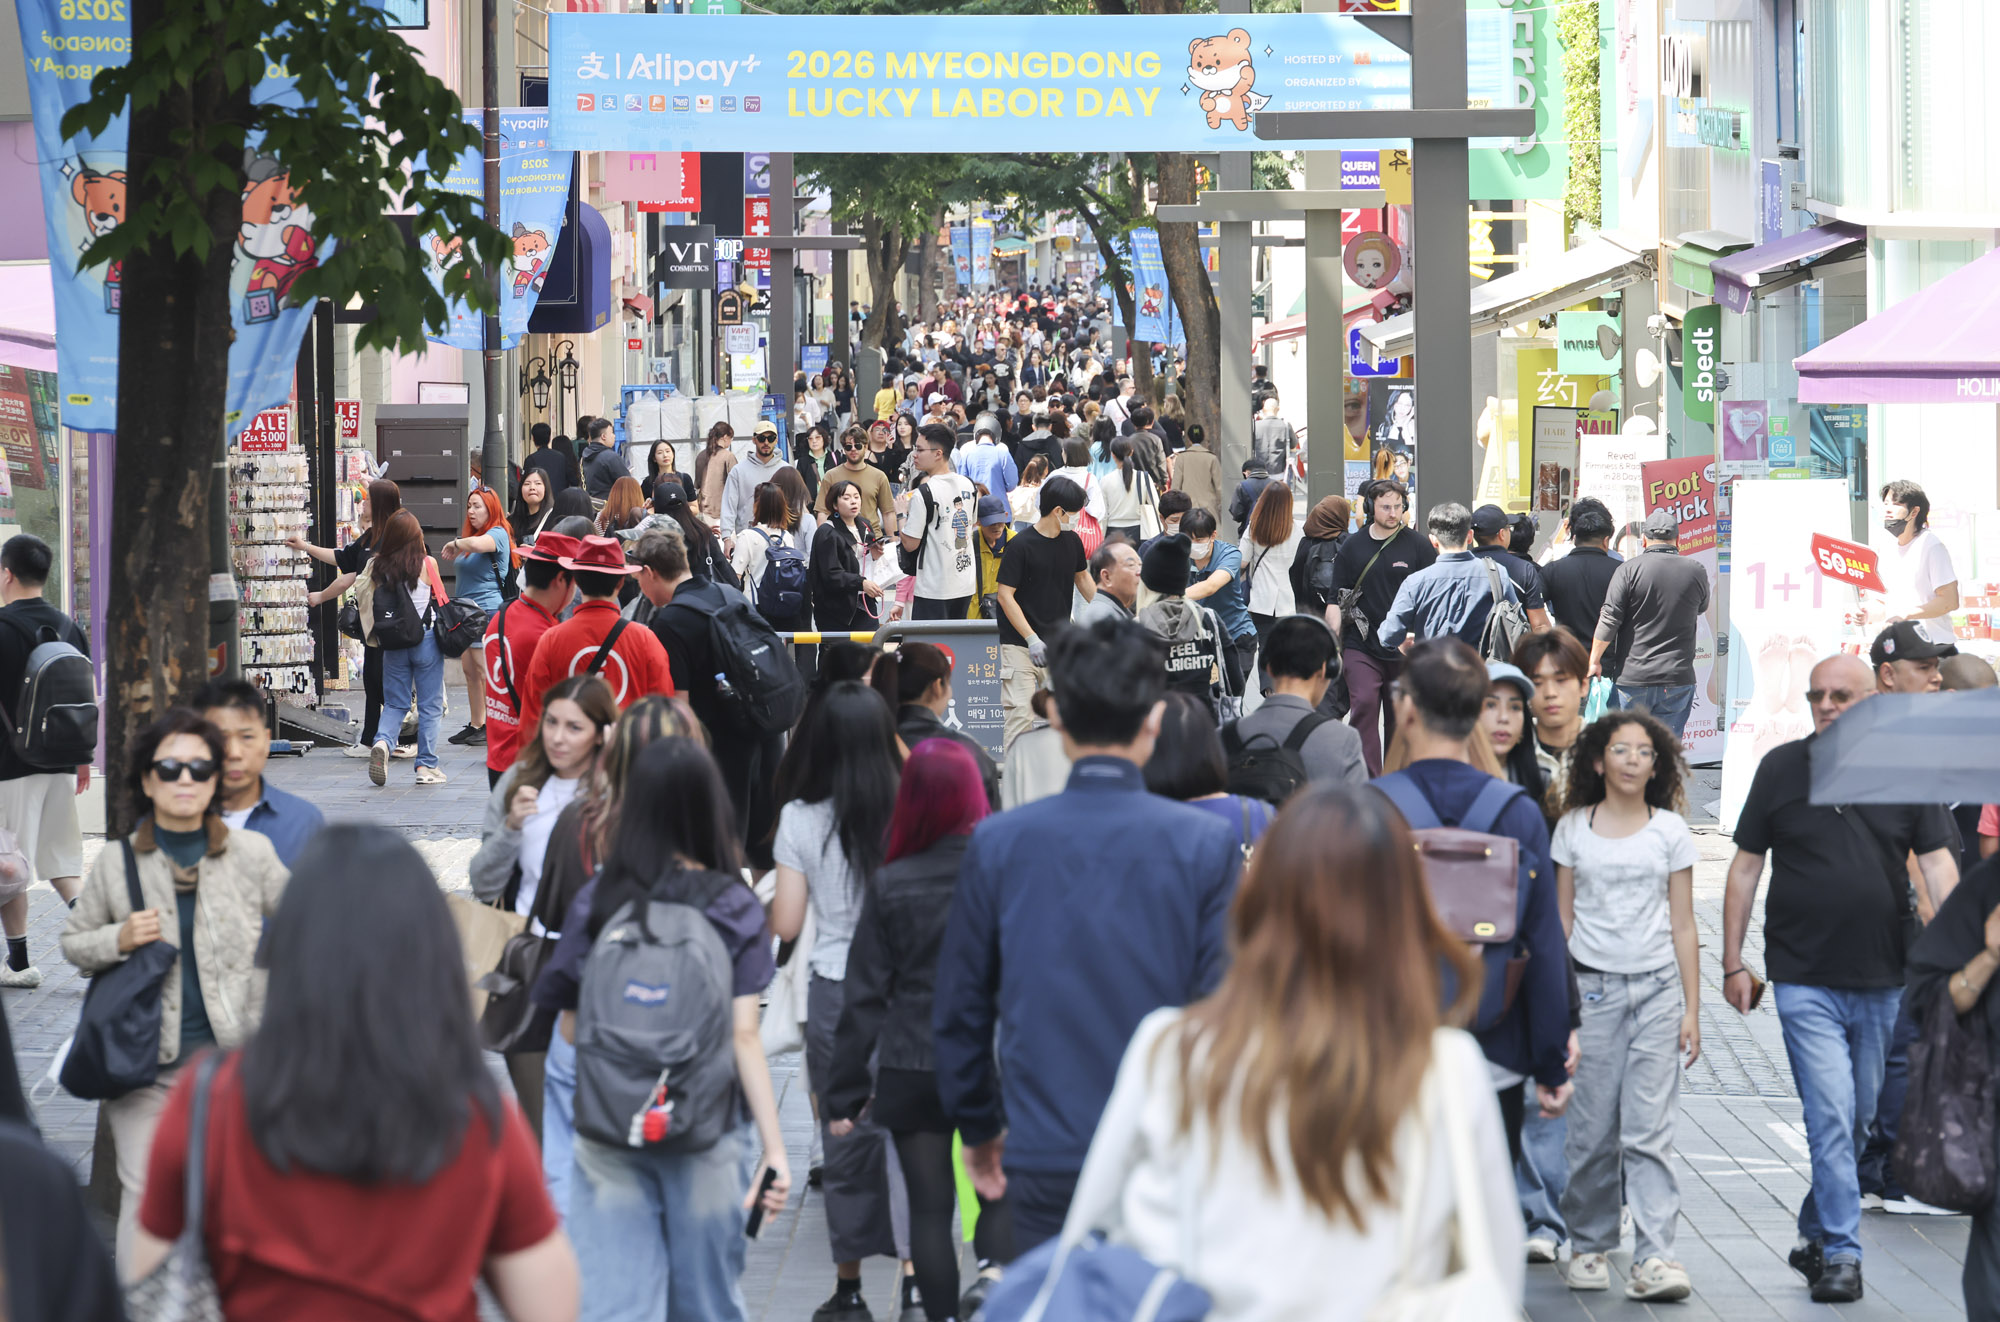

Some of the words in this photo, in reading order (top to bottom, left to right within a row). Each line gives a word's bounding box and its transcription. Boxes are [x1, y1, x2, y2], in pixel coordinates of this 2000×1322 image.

[787, 50, 875, 79] 2026
[885, 51, 1161, 79] MYEONGDONG
[1284, 55, 1326, 64] HOSTED
[1328, 55, 1342, 64] BY
[1285, 78, 1346, 87] ORGANIZED
[1348, 77, 1361, 87] BY
[788, 88, 921, 117] LUCKY
[932, 88, 1065, 117] LABOR
[1076, 87, 1161, 117] DAY
[1285, 101, 1346, 110] SUPPORTED
[1348, 101, 1362, 110] BY
[1342, 161, 1376, 172] QUEEN
[670, 242, 709, 263] VT
[670, 264, 709, 272] COSMETICS
[1692, 327, 1714, 402] sbedt
[243, 432, 258, 442] 2EA
[1544, 428, 1566, 436] HAIR
[1607, 451, 1636, 460] Reveal
[1650, 472, 1700, 505] Foot
[1703, 535, 1713, 544] the
[1846, 557, 1871, 573] SALE
[1848, 568, 1864, 580] OFF
[986, 645, 998, 660] 명
[1170, 642, 1200, 658] FEEL
[968, 663, 981, 677] 차
[968, 709, 986, 720] 매일
[1686, 720, 1711, 728] BUTTER
[1694, 729, 1718, 738] FOOT
